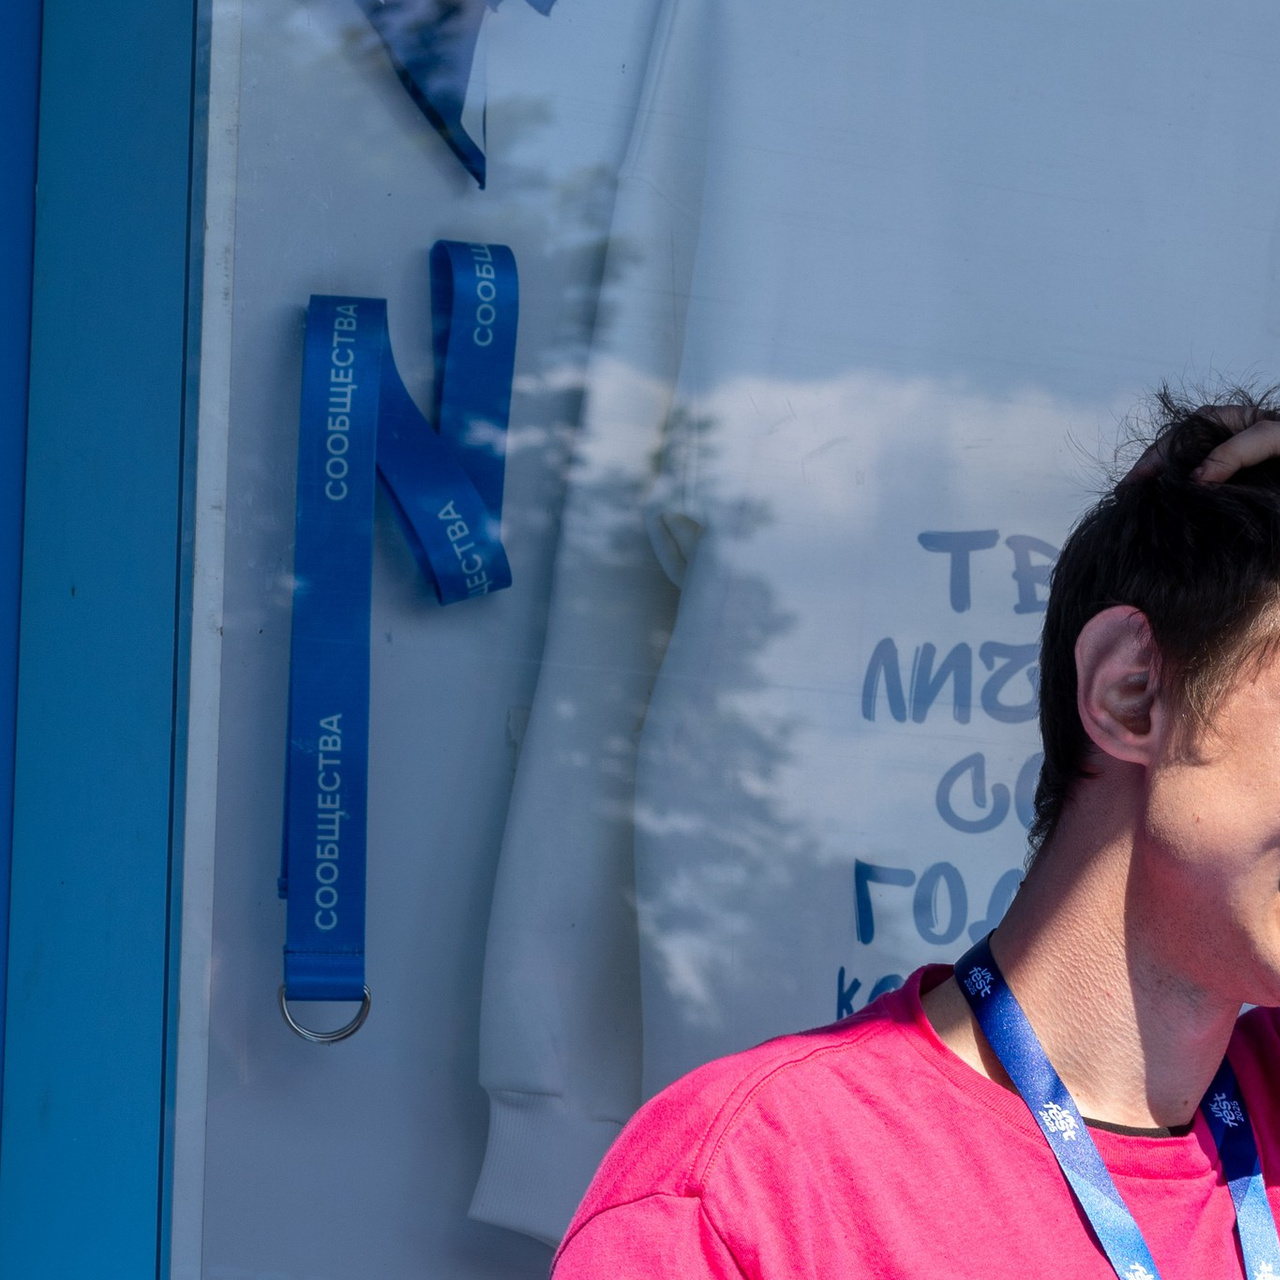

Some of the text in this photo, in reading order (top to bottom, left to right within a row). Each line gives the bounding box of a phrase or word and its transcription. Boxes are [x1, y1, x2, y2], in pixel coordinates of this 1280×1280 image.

[325, 304, 358, 502] СООБЩЕСТВА
[315, 713, 342, 931] СООБЩЕСТВА
[969, 967, 991, 997] fest
[981, 968, 994, 984] VK
[1043, 1101, 1076, 1141] fest
[1213, 1093, 1238, 1127] fest
